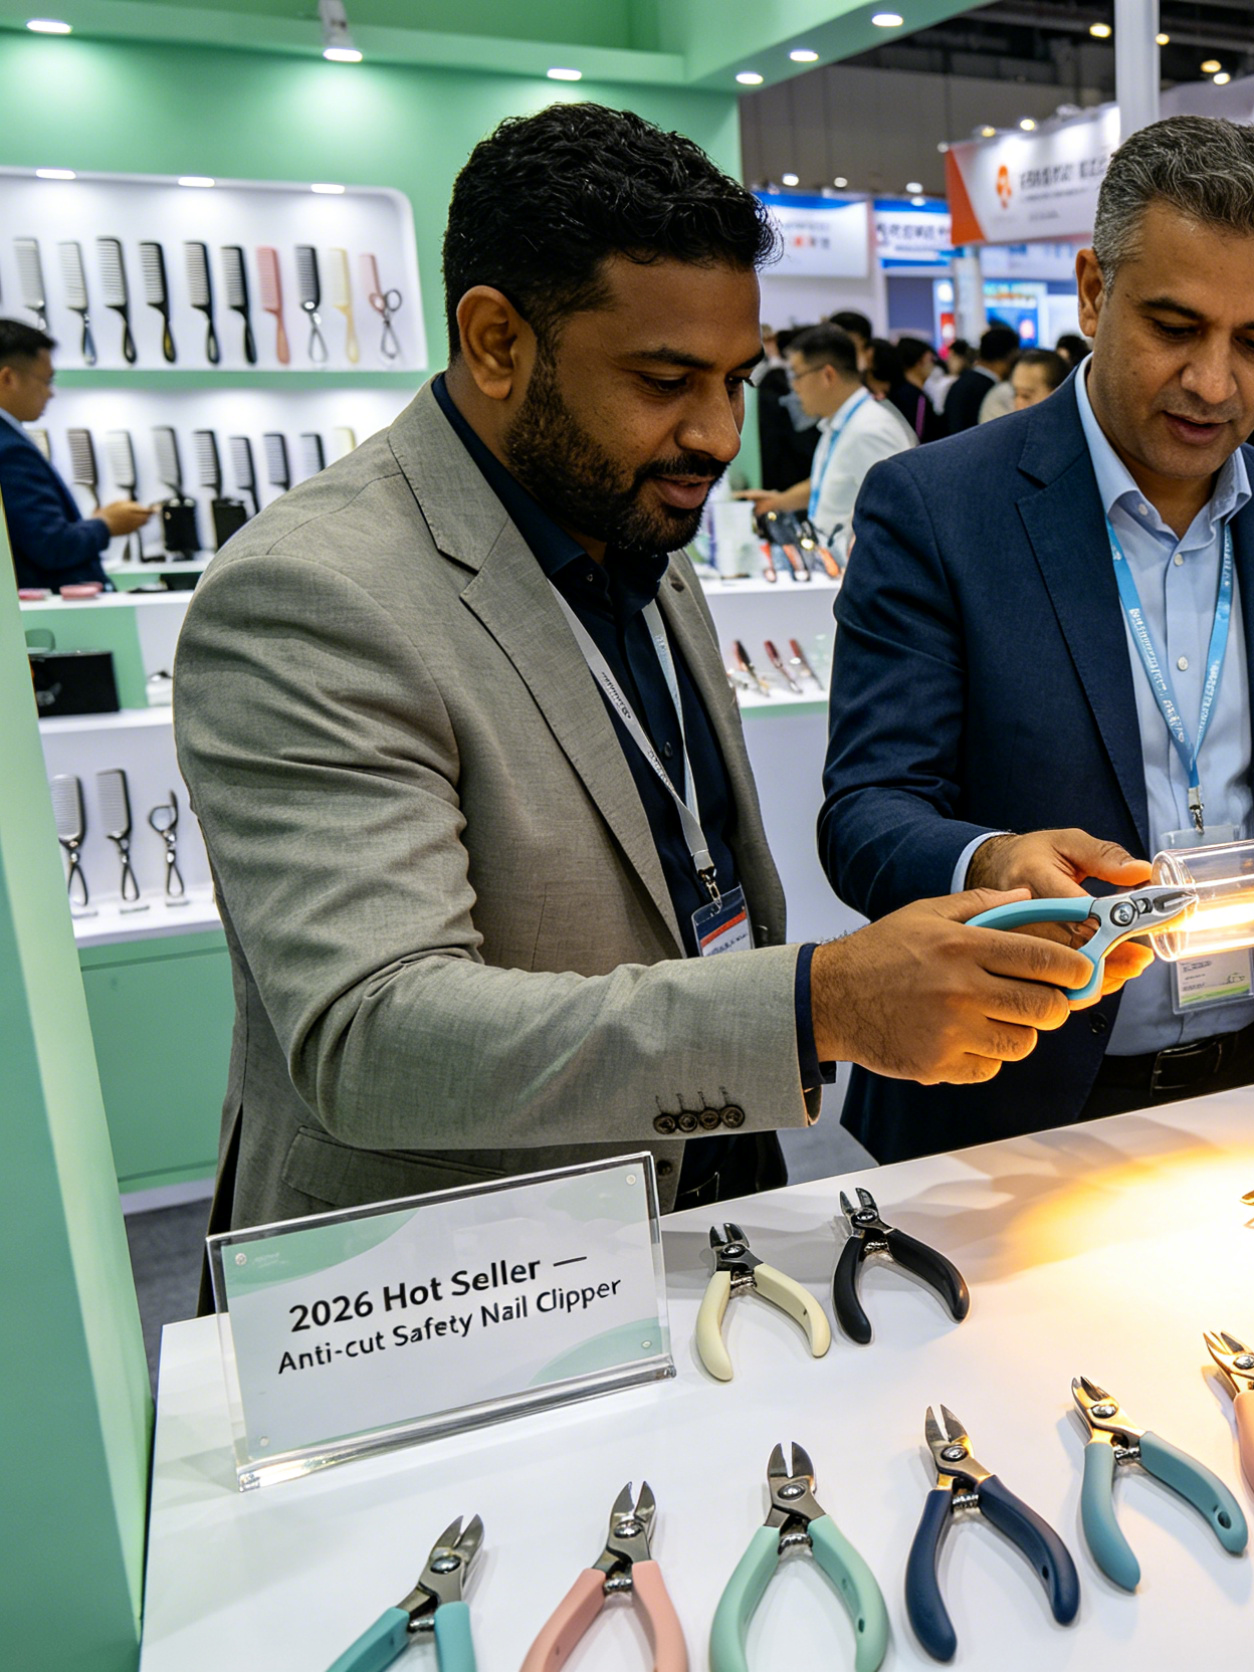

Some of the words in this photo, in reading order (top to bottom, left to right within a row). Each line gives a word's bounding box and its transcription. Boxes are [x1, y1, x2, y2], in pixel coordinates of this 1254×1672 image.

[278, 1330, 386, 1375] Anti-cut
[393, 1312, 474, 1350] Safety
[480, 1296, 529, 1328] Nail
[535, 1278, 622, 1315] Clipper
[289, 1290, 374, 1333] 2026
[382, 1276, 443, 1313] Hot
[450, 1260, 542, 1297] Seller
